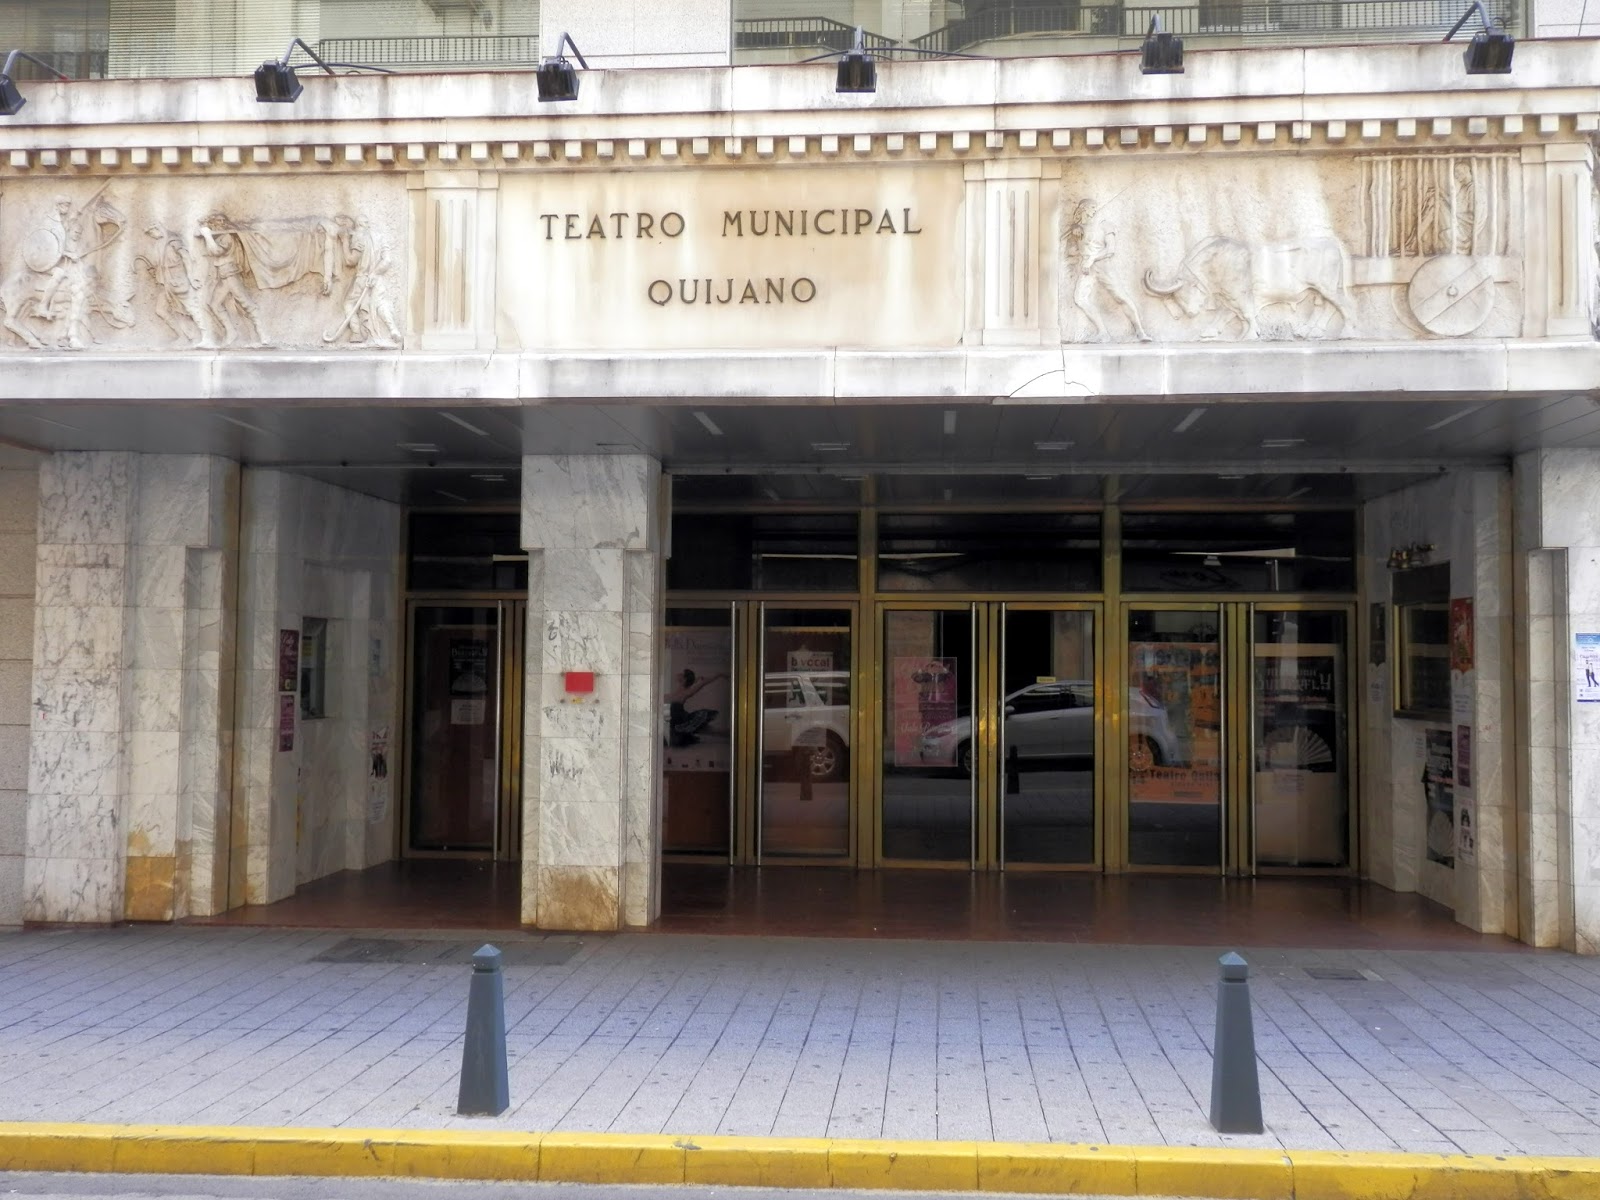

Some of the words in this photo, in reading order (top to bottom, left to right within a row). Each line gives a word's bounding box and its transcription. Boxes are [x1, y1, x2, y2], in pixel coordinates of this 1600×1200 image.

[540, 211, 685, 240] TEATRO
[721, 207, 922, 237] MUNICIPAL
[648, 277, 817, 306] QUIJANO
